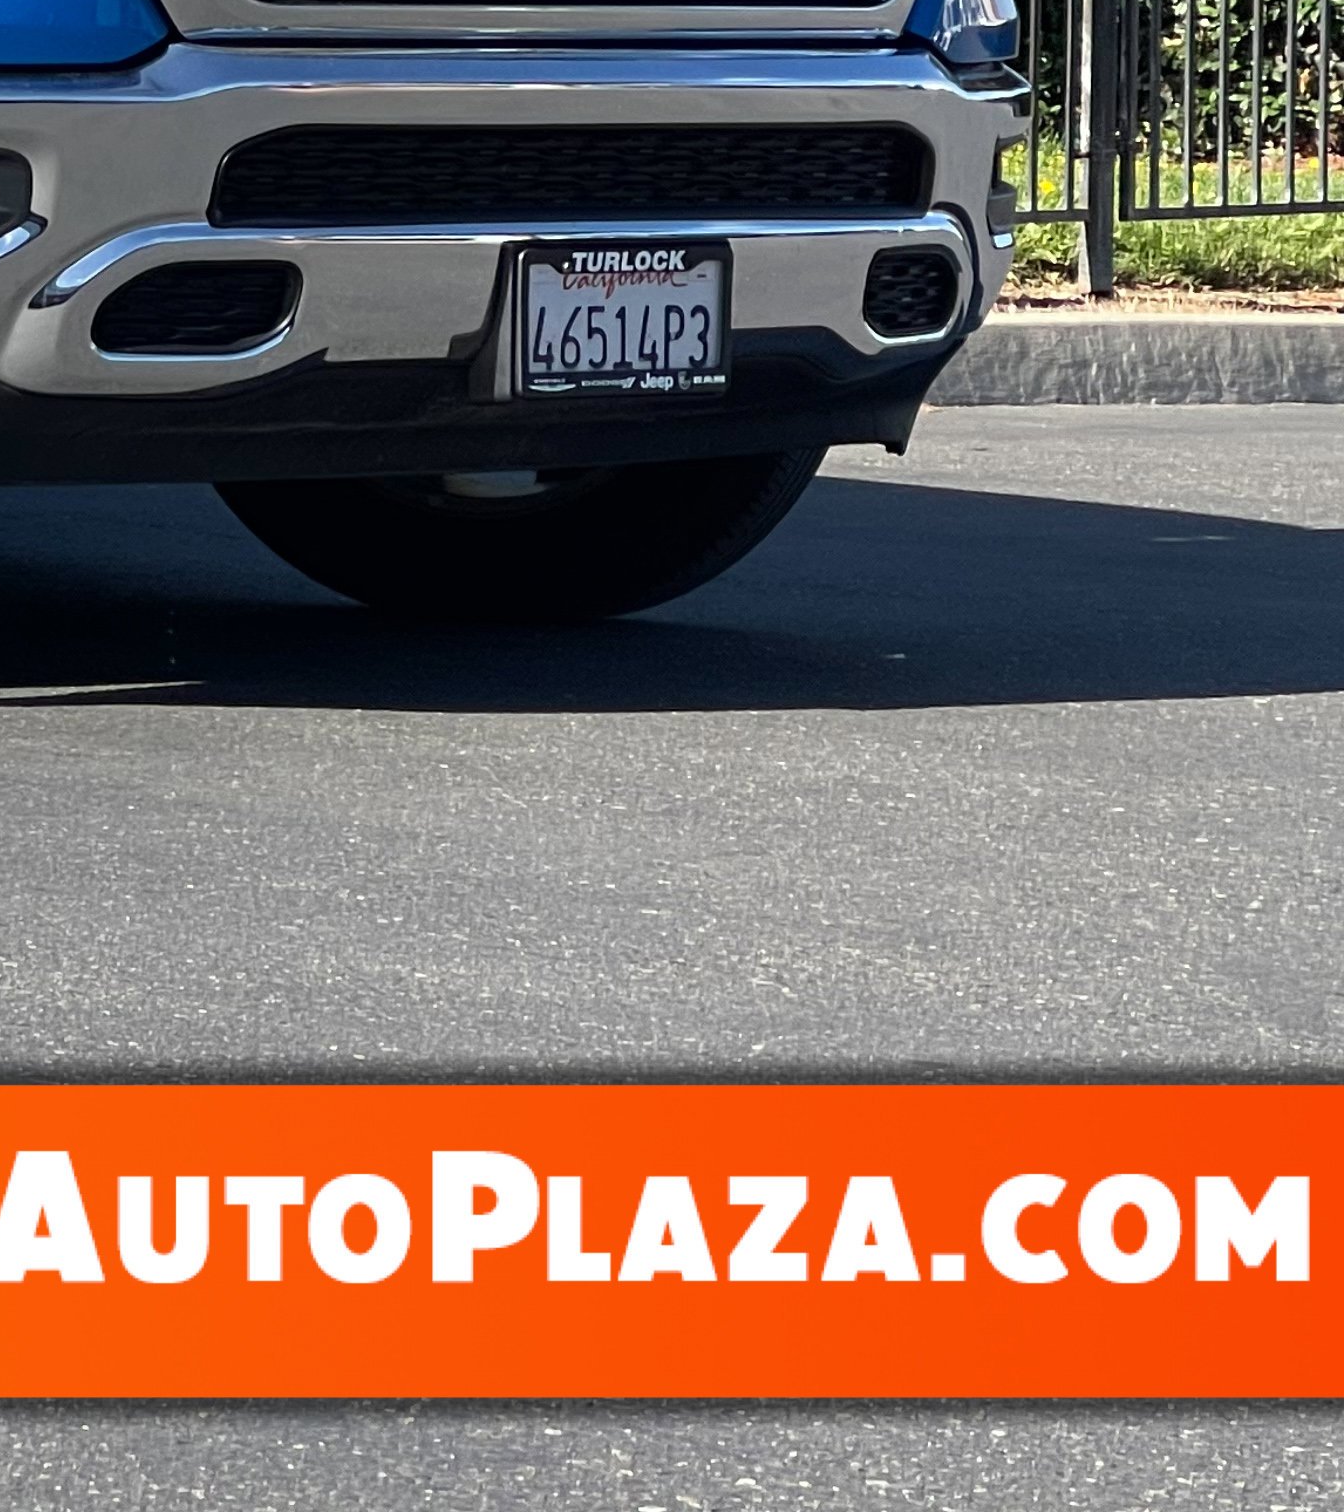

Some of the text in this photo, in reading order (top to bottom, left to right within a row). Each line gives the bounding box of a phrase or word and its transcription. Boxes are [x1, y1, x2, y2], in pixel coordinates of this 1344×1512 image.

[572, 250, 685, 272] TURLOCK
[533, 304, 710, 370] 46514P3
[640, 372, 674, 391] Jeep
